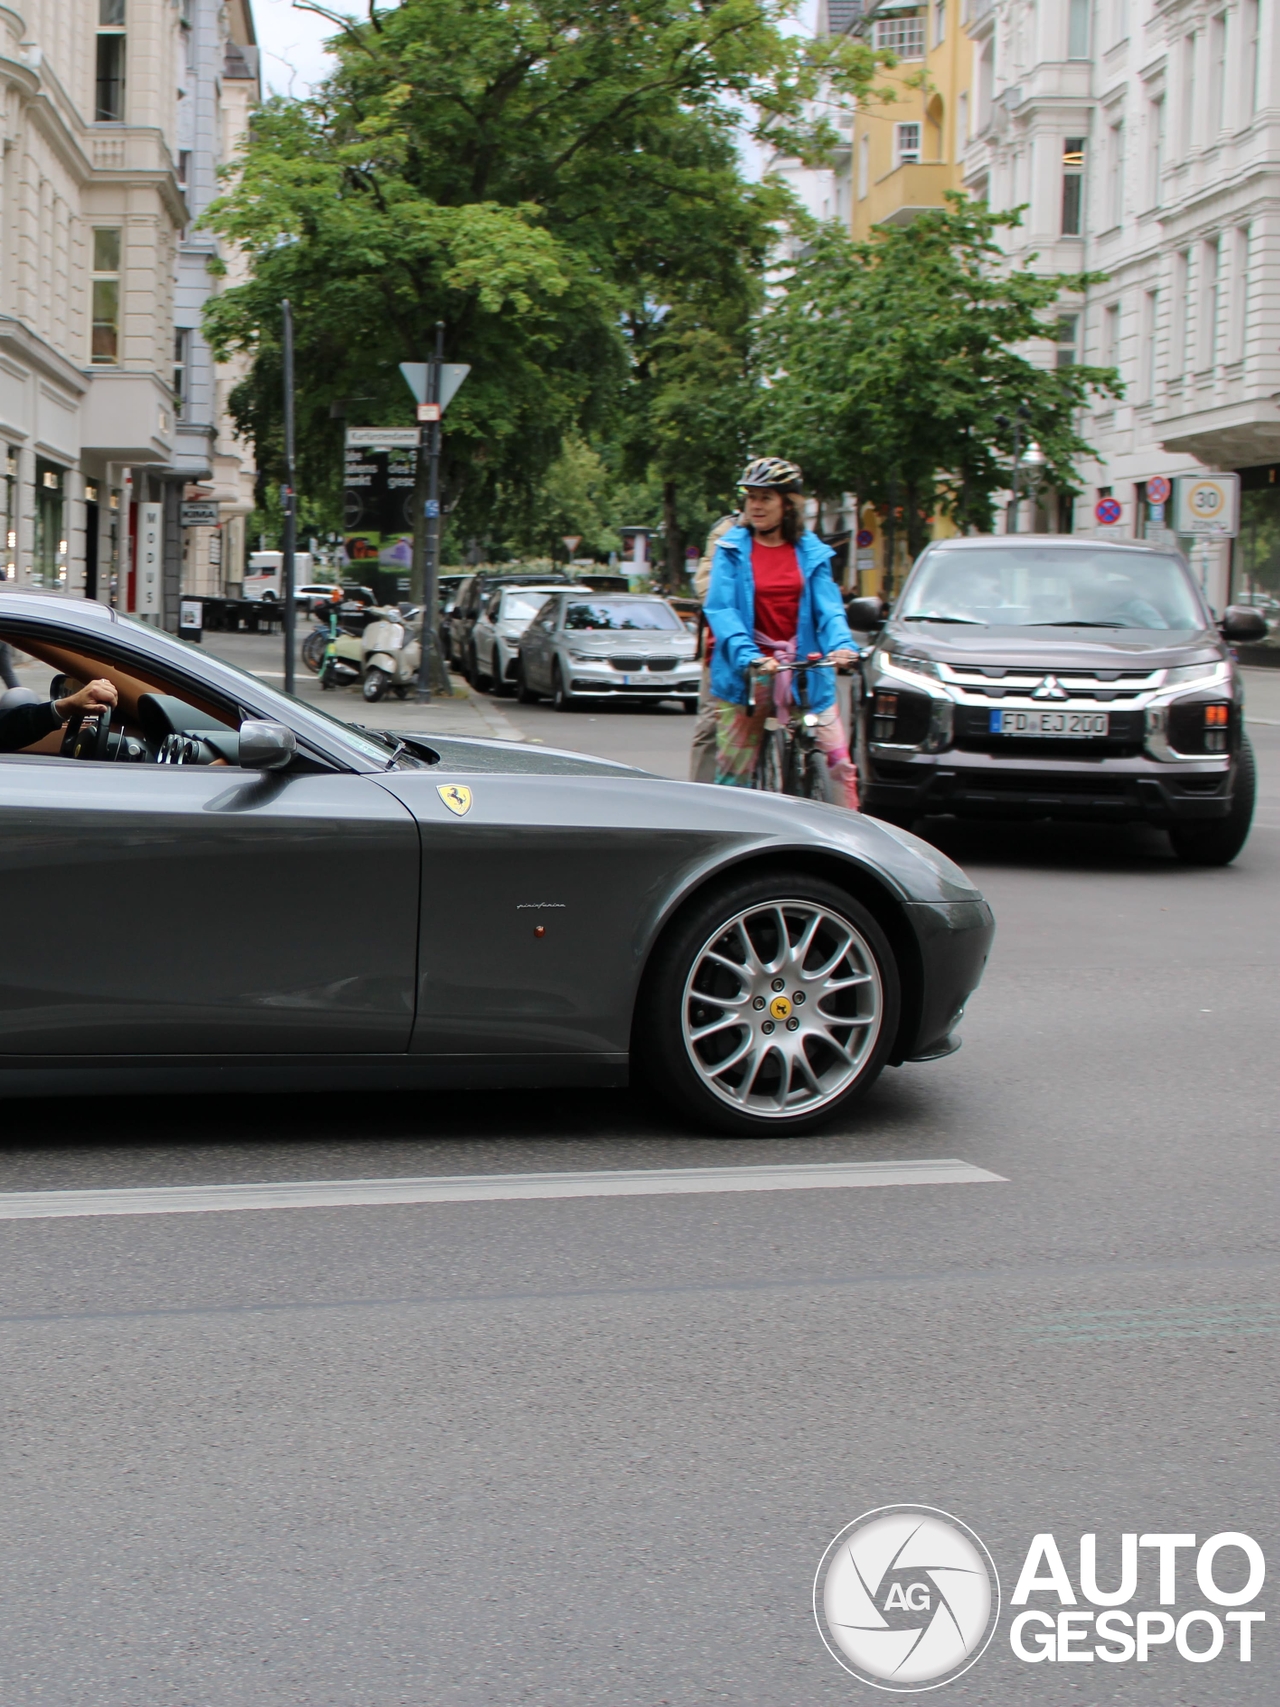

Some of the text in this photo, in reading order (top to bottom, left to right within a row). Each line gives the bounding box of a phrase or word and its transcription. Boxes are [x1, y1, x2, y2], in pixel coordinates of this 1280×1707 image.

[1195, 491, 1219, 508] 30
[146, 512, 157, 603] MODUS
[1003, 713, 1106, 733] FD EJ 200
